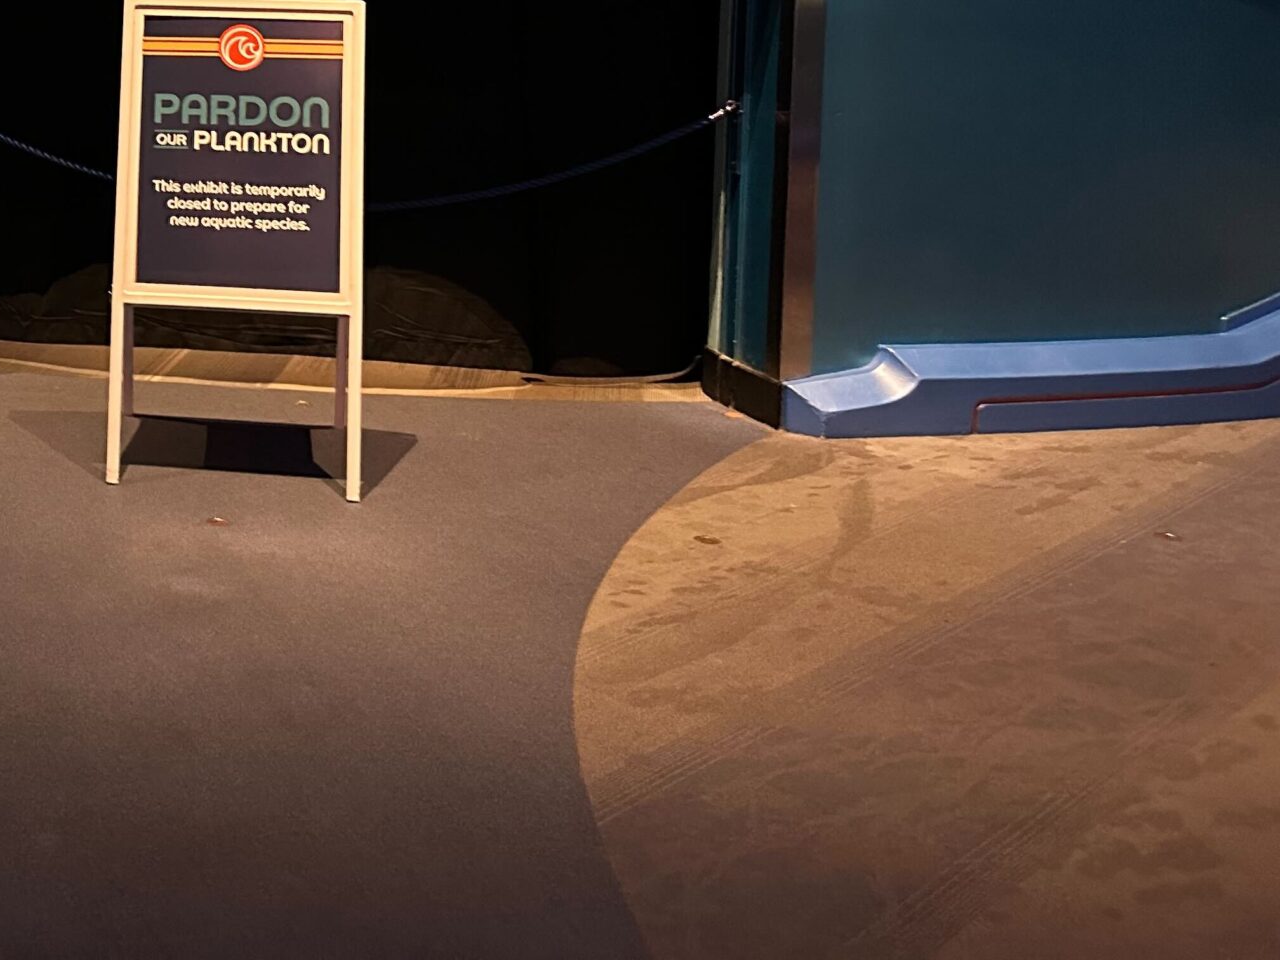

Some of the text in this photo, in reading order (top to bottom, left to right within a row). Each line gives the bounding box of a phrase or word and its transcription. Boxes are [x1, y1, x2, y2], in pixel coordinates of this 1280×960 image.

[153, 93, 330, 129] PARDON
[155, 130, 331, 155] OUR PLANKTON
[152, 179, 327, 201] This exhibit is temporarily
[166, 196, 311, 216] closed to prepare for
[169, 214, 311, 233] new aquatic species.
